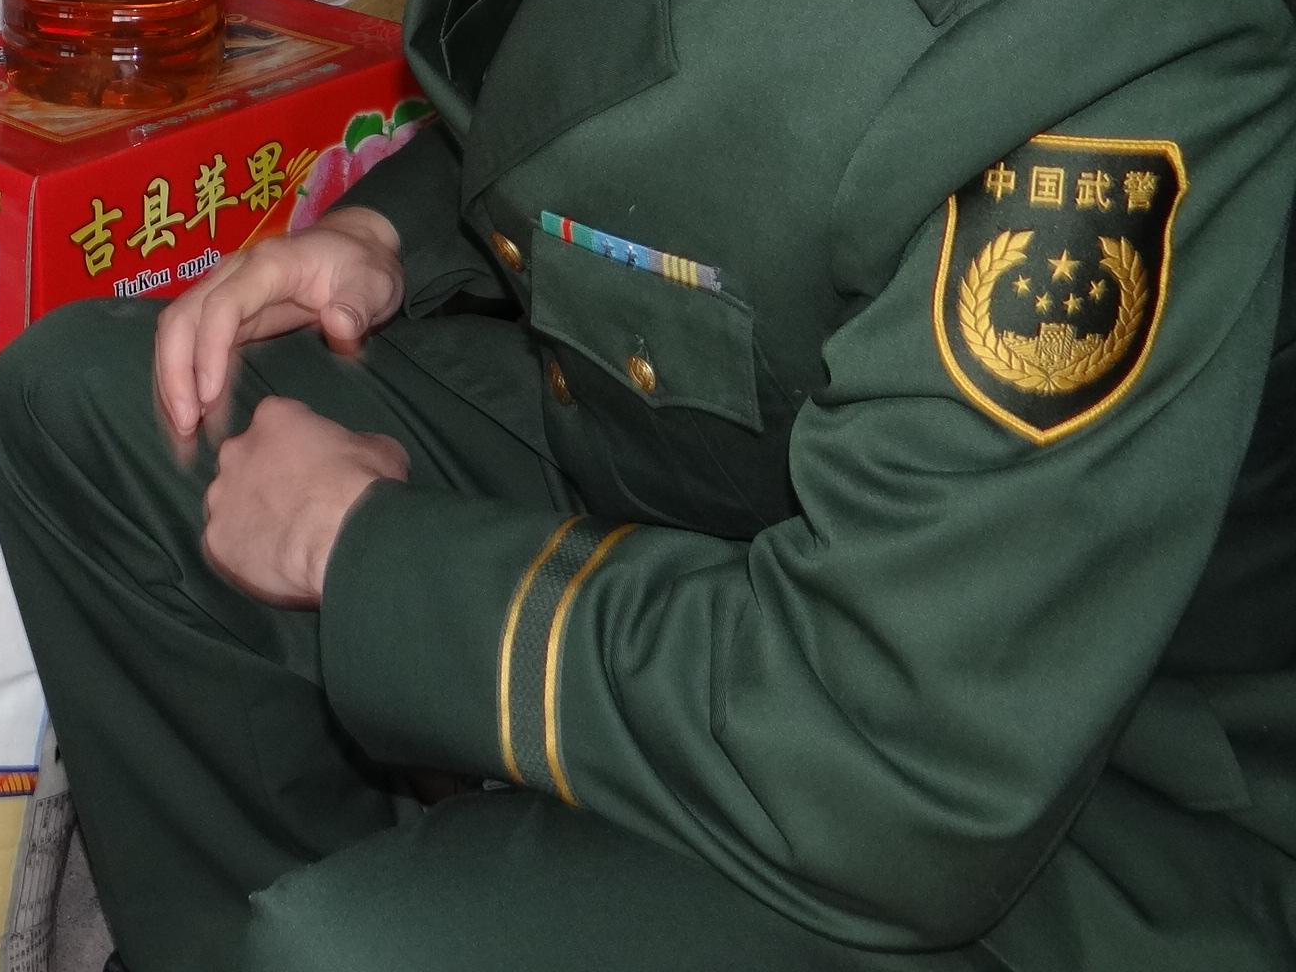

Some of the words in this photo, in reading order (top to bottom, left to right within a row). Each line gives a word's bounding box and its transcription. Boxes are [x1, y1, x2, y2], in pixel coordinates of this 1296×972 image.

[70, 141, 286, 276] 吉县苹果
[985, 161, 1157, 213] 中国武警
[114, 268, 171, 297] HuKou
[177, 248, 220, 279] apple
